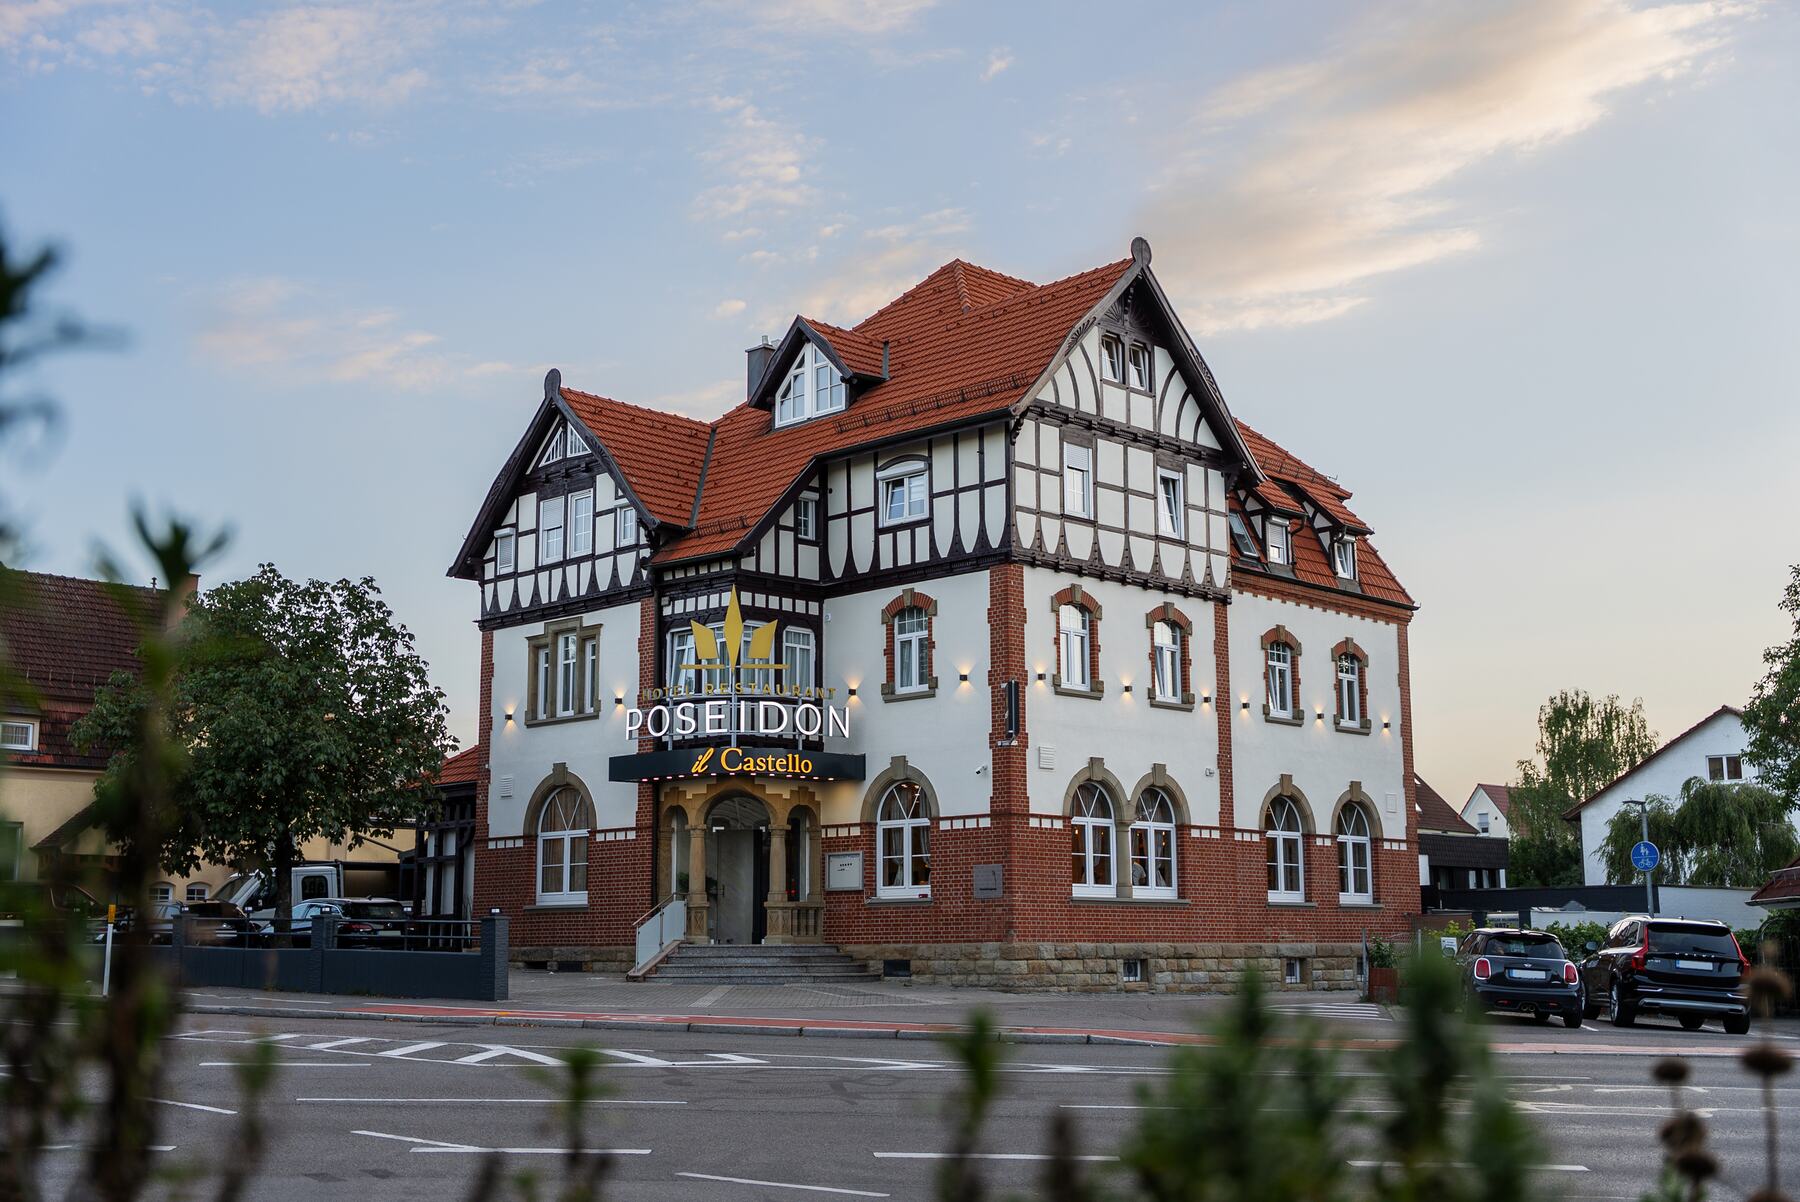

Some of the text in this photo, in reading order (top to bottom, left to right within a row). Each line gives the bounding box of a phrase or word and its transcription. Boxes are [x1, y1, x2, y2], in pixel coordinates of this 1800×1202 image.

[642, 683, 836, 701] HOTEL RESTAURANT
[625, 700, 850, 740] POSEIDON
[690, 747, 813, 774] il Castello
